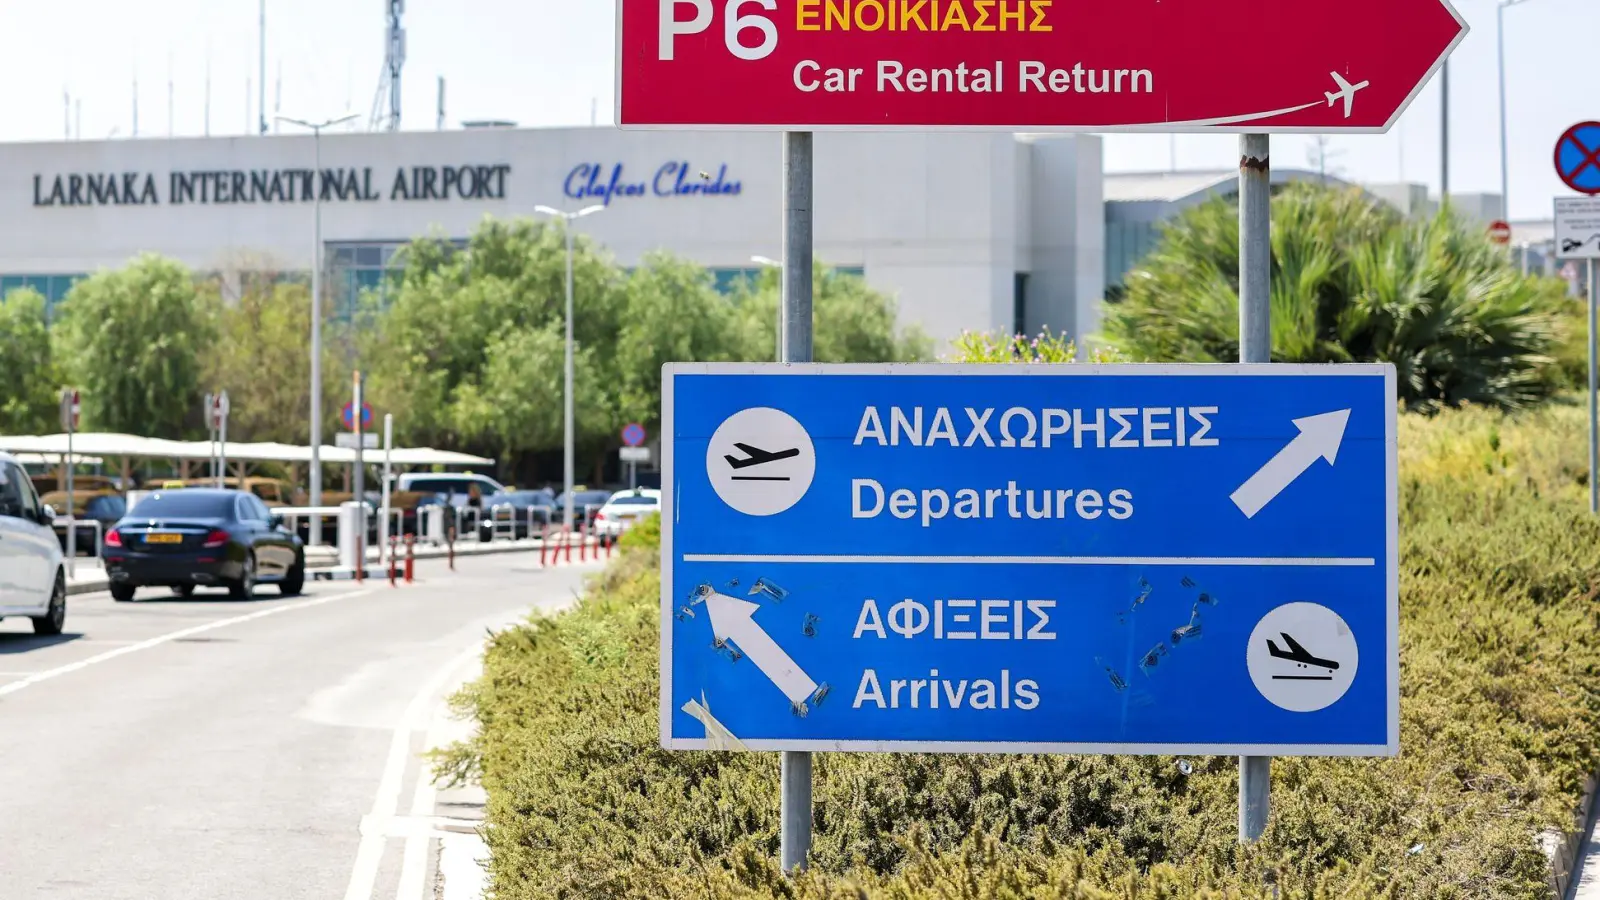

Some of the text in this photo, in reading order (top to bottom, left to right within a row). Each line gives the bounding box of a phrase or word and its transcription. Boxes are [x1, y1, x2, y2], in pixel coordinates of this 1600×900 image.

[657, 0, 779, 61] P6
[795, 0, 1054, 32] ΕΝΟΙΚΙΑΣΗΣ
[792, 59, 1154, 94] Car Rental Return
[33, 163, 511, 207] LARNAKA INTERNATIONAL AIRPORT
[563, 160, 742, 207] Glafcos Clerides
[852, 405, 1221, 449] ΑΝΑΧΩΡΗΣΕΙΣ
[850, 477, 1135, 528] Departures
[851, 597, 1058, 641] ΑΦΙΞΕΙΣ
[851, 667, 1041, 711] Arrivals
